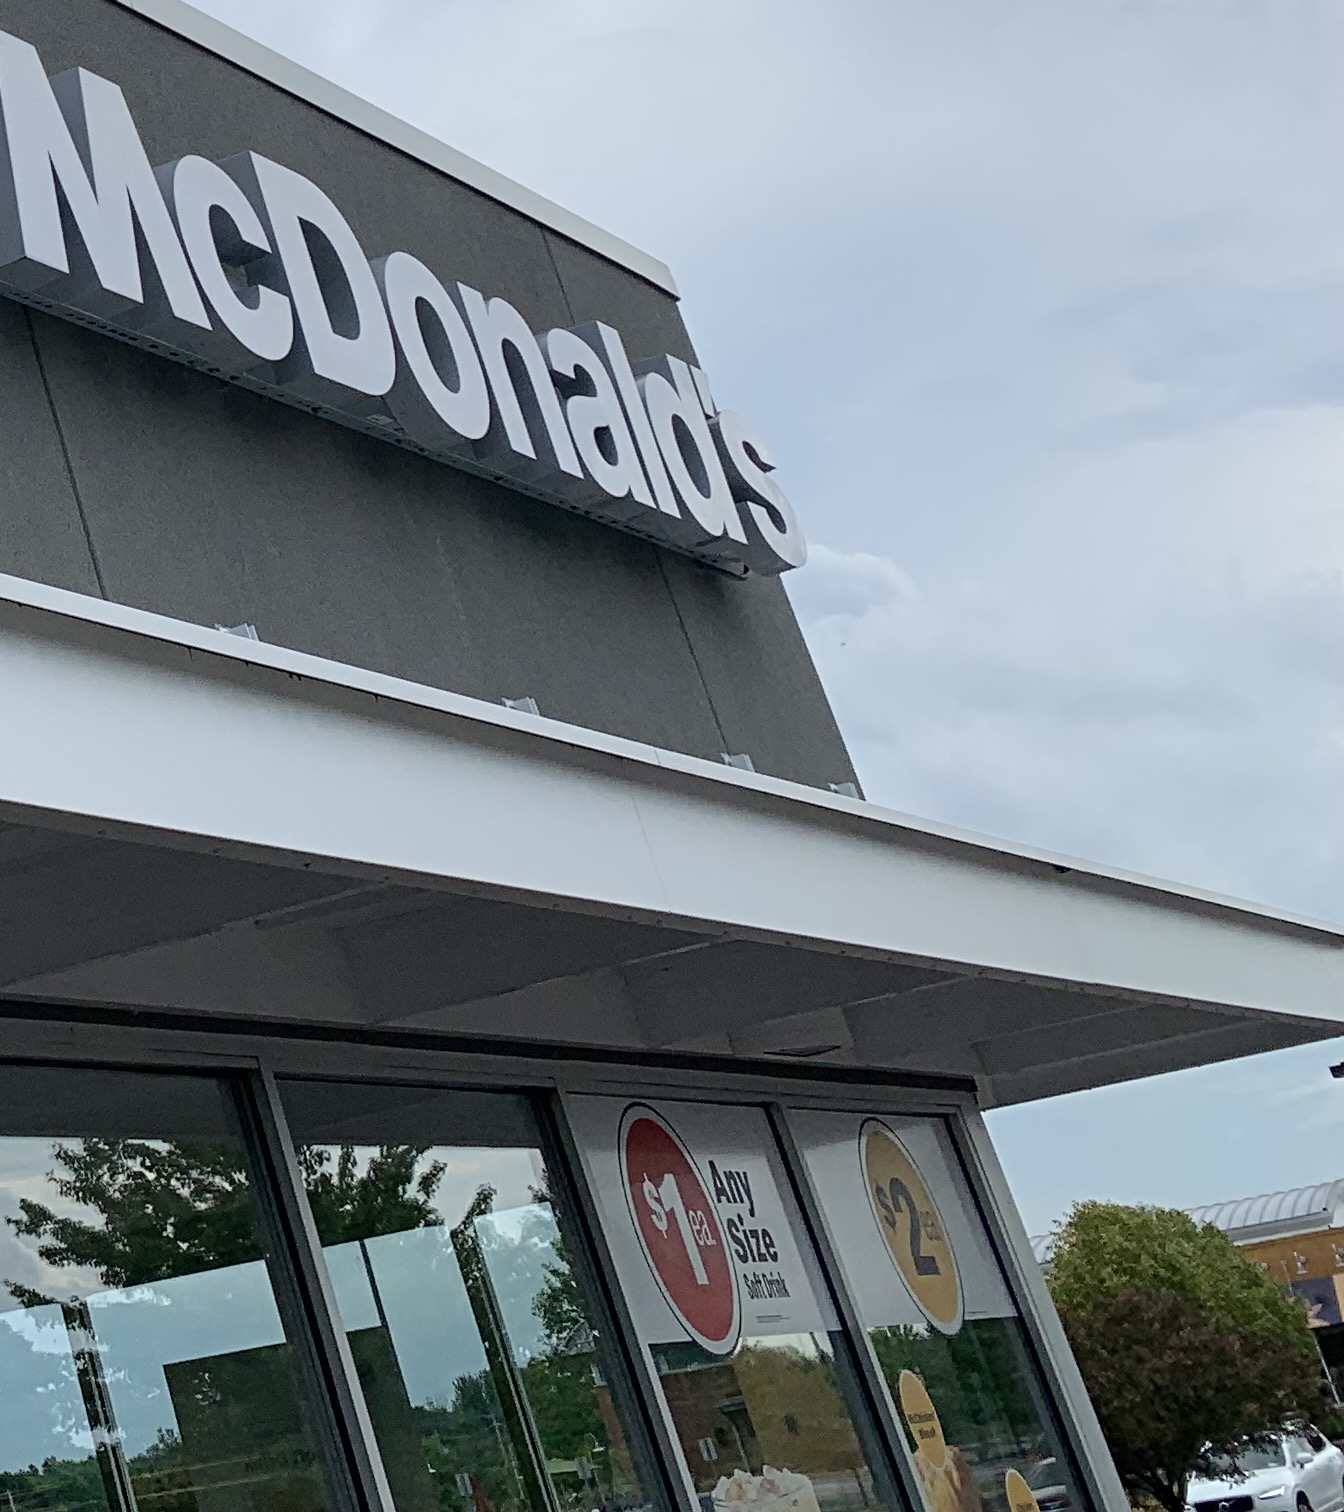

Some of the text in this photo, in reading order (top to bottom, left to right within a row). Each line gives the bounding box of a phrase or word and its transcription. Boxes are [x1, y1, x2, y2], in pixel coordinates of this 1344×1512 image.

[708, 1159, 756, 1218] Any
[726, 1212, 779, 1264] Size
[743, 1271, 791, 1300] Soft Drink
